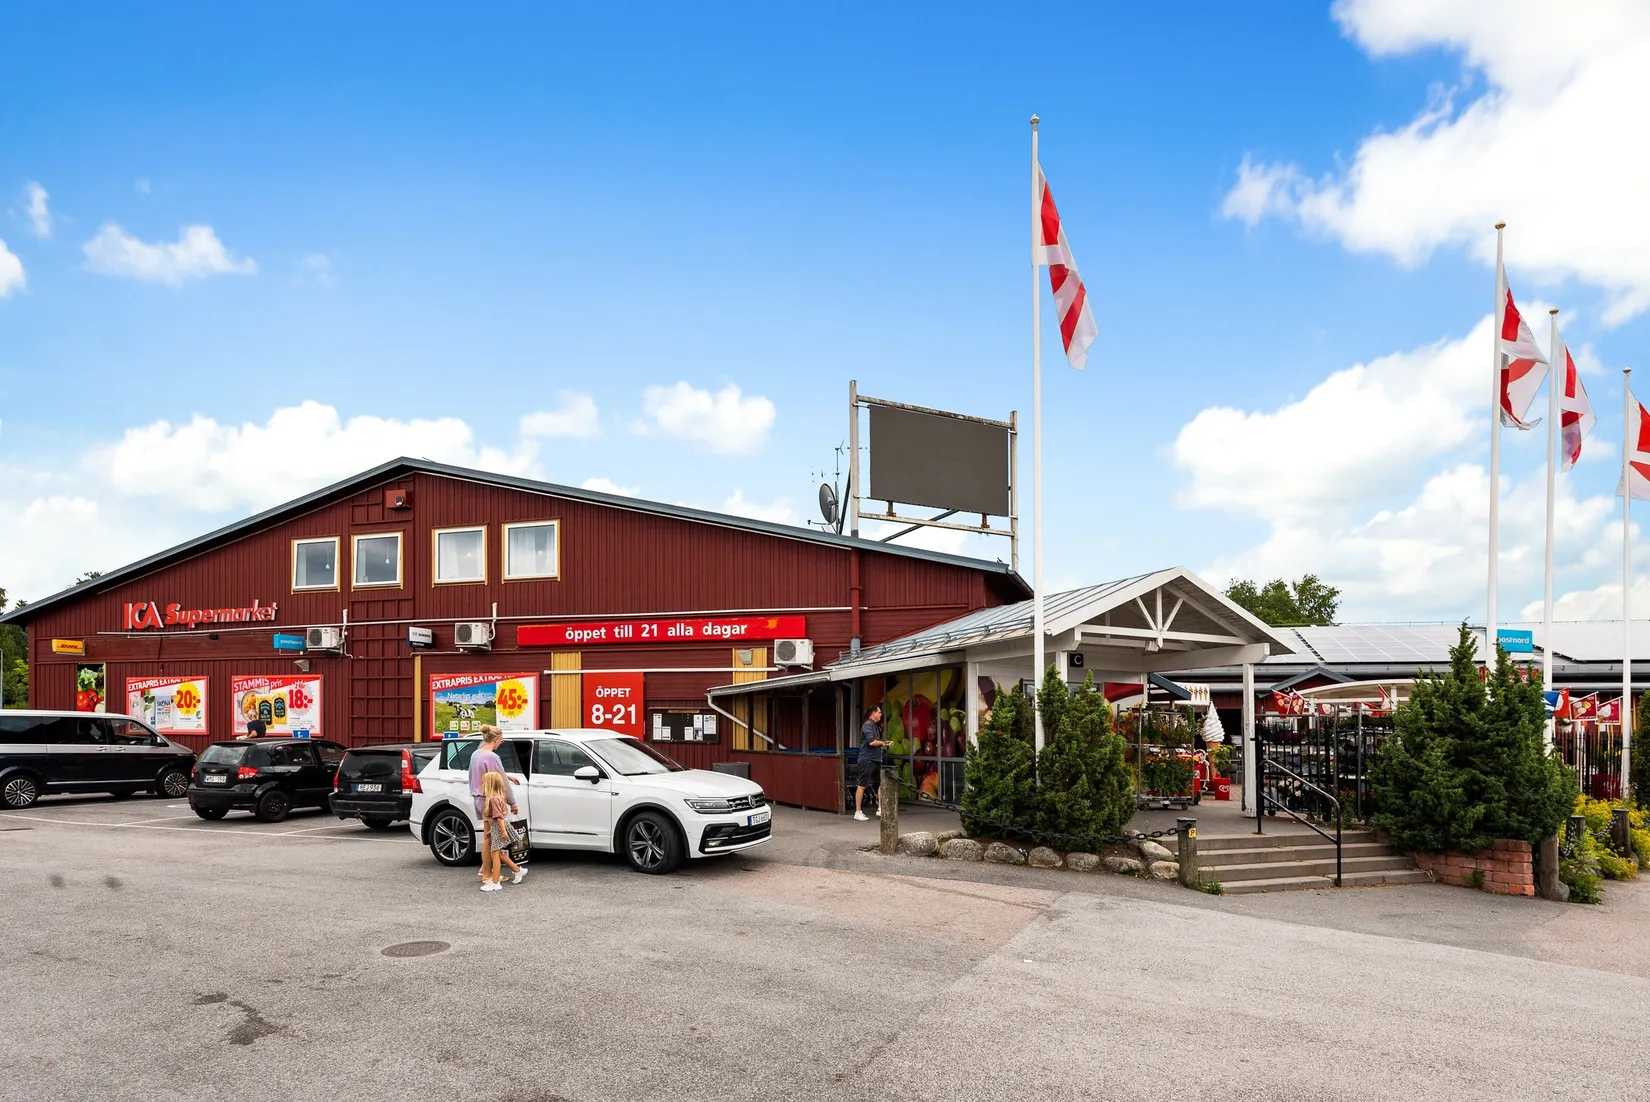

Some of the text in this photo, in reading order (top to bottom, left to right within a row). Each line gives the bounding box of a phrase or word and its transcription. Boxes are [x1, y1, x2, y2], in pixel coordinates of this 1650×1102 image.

[123, 599, 278, 629] ICA Supermarket
[565, 622, 748, 642] öppet till 21 alla dagar
[128, 680, 159, 691] EXTRAPRIS
[233, 678, 283, 692] STAMMIS pris
[432, 676, 473, 689] EXTRAPRIS
[595, 685, 631, 698] ÖPPET
[176, 690, 201, 709] 20:-
[288, 690, 313, 709] 18:-
[497, 689, 529, 710] 45:-
[591, 704, 636, 725] 8-21
